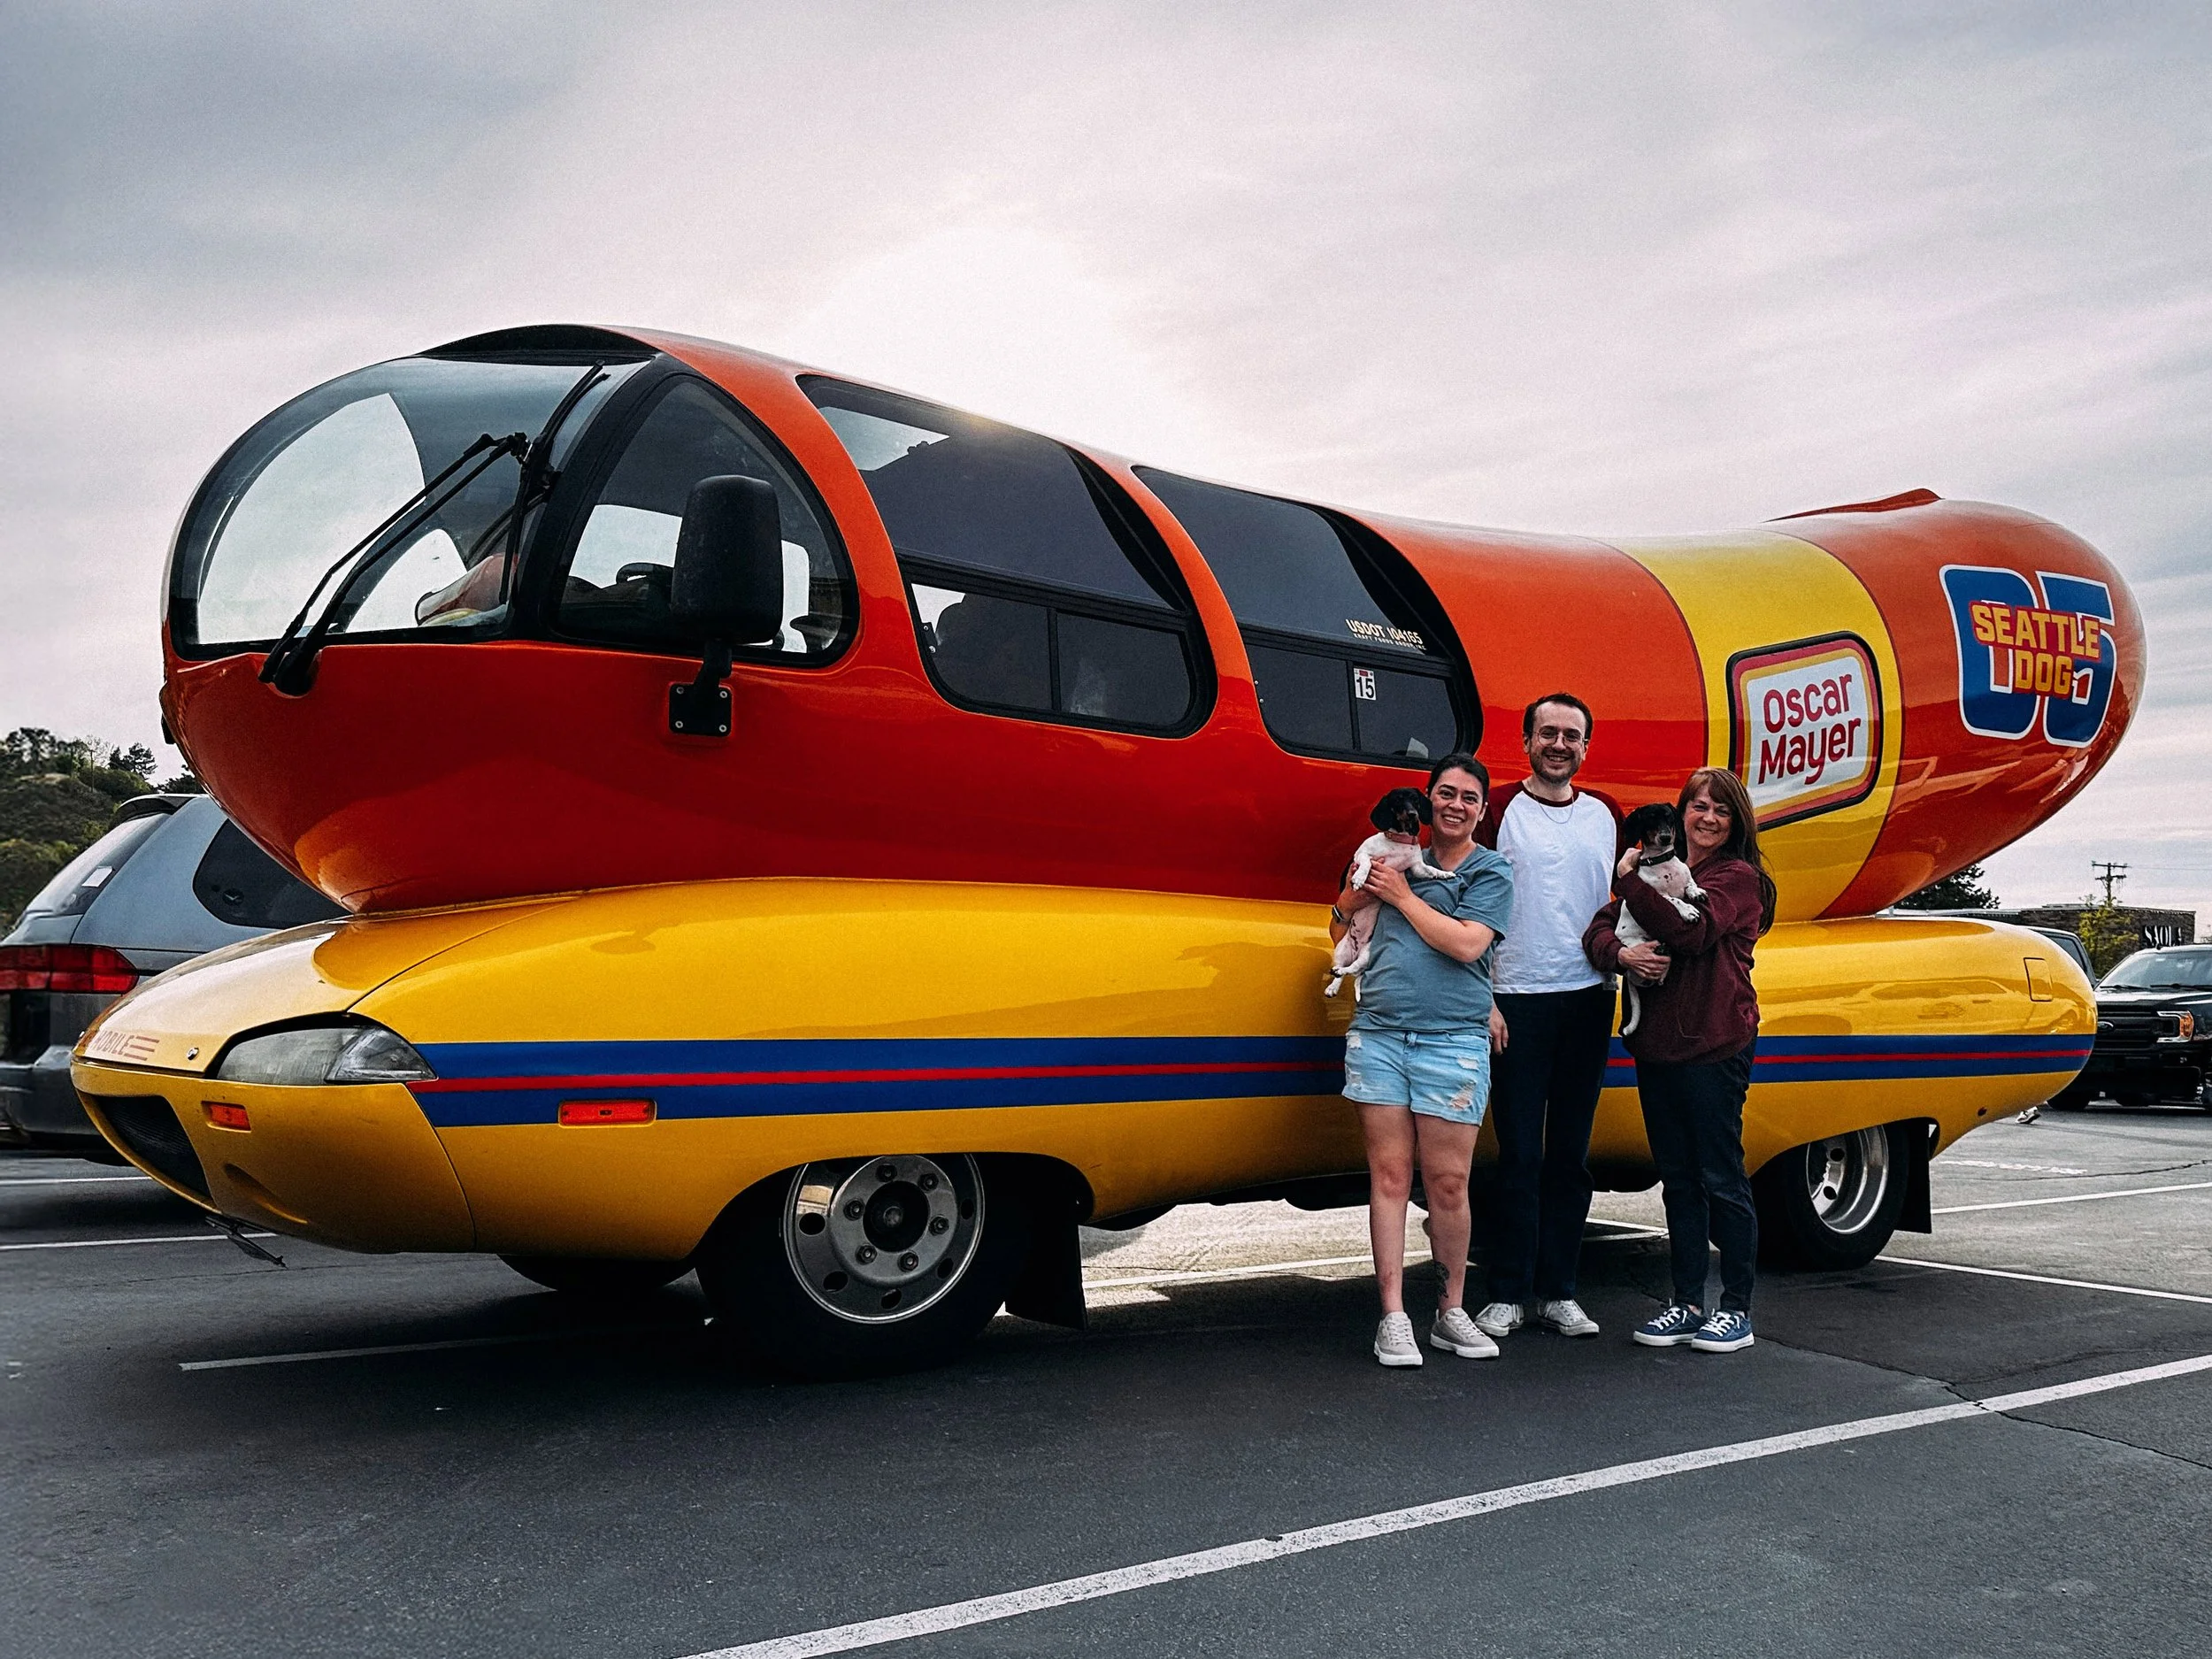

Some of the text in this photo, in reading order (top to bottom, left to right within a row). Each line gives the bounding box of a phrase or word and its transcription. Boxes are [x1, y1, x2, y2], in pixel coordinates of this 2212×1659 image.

[1345, 618, 1423, 645] USDOT 104165
[1971, 604, 2101, 658] SEATTLE
[1356, 676, 1374, 698] 15
[2014, 649, 2072, 695] DOG
[1763, 673, 1853, 733] Oscar
[1758, 718, 1862, 785] Mayer
